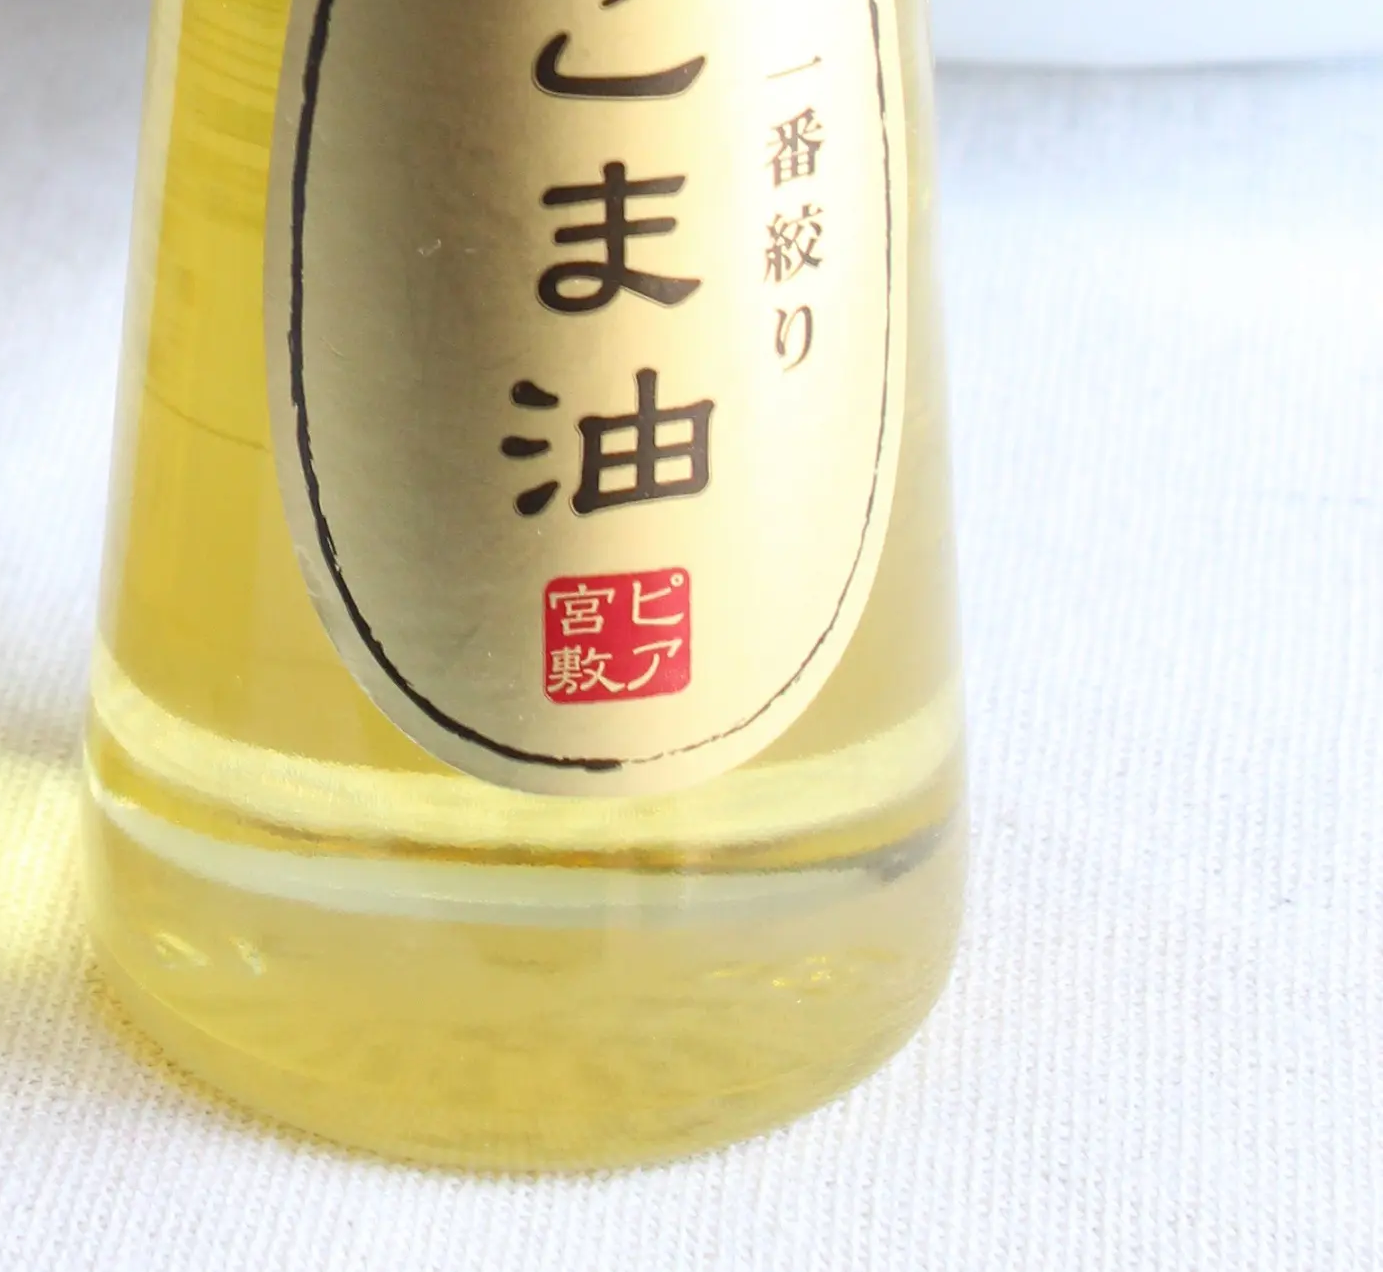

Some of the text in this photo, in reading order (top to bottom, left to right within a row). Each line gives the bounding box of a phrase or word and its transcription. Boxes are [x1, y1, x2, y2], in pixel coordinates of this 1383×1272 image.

[762, 55, 825, 373] 一番絞り
[546, 582, 626, 695] 宮敷
[626, 572, 685, 692] ピア
